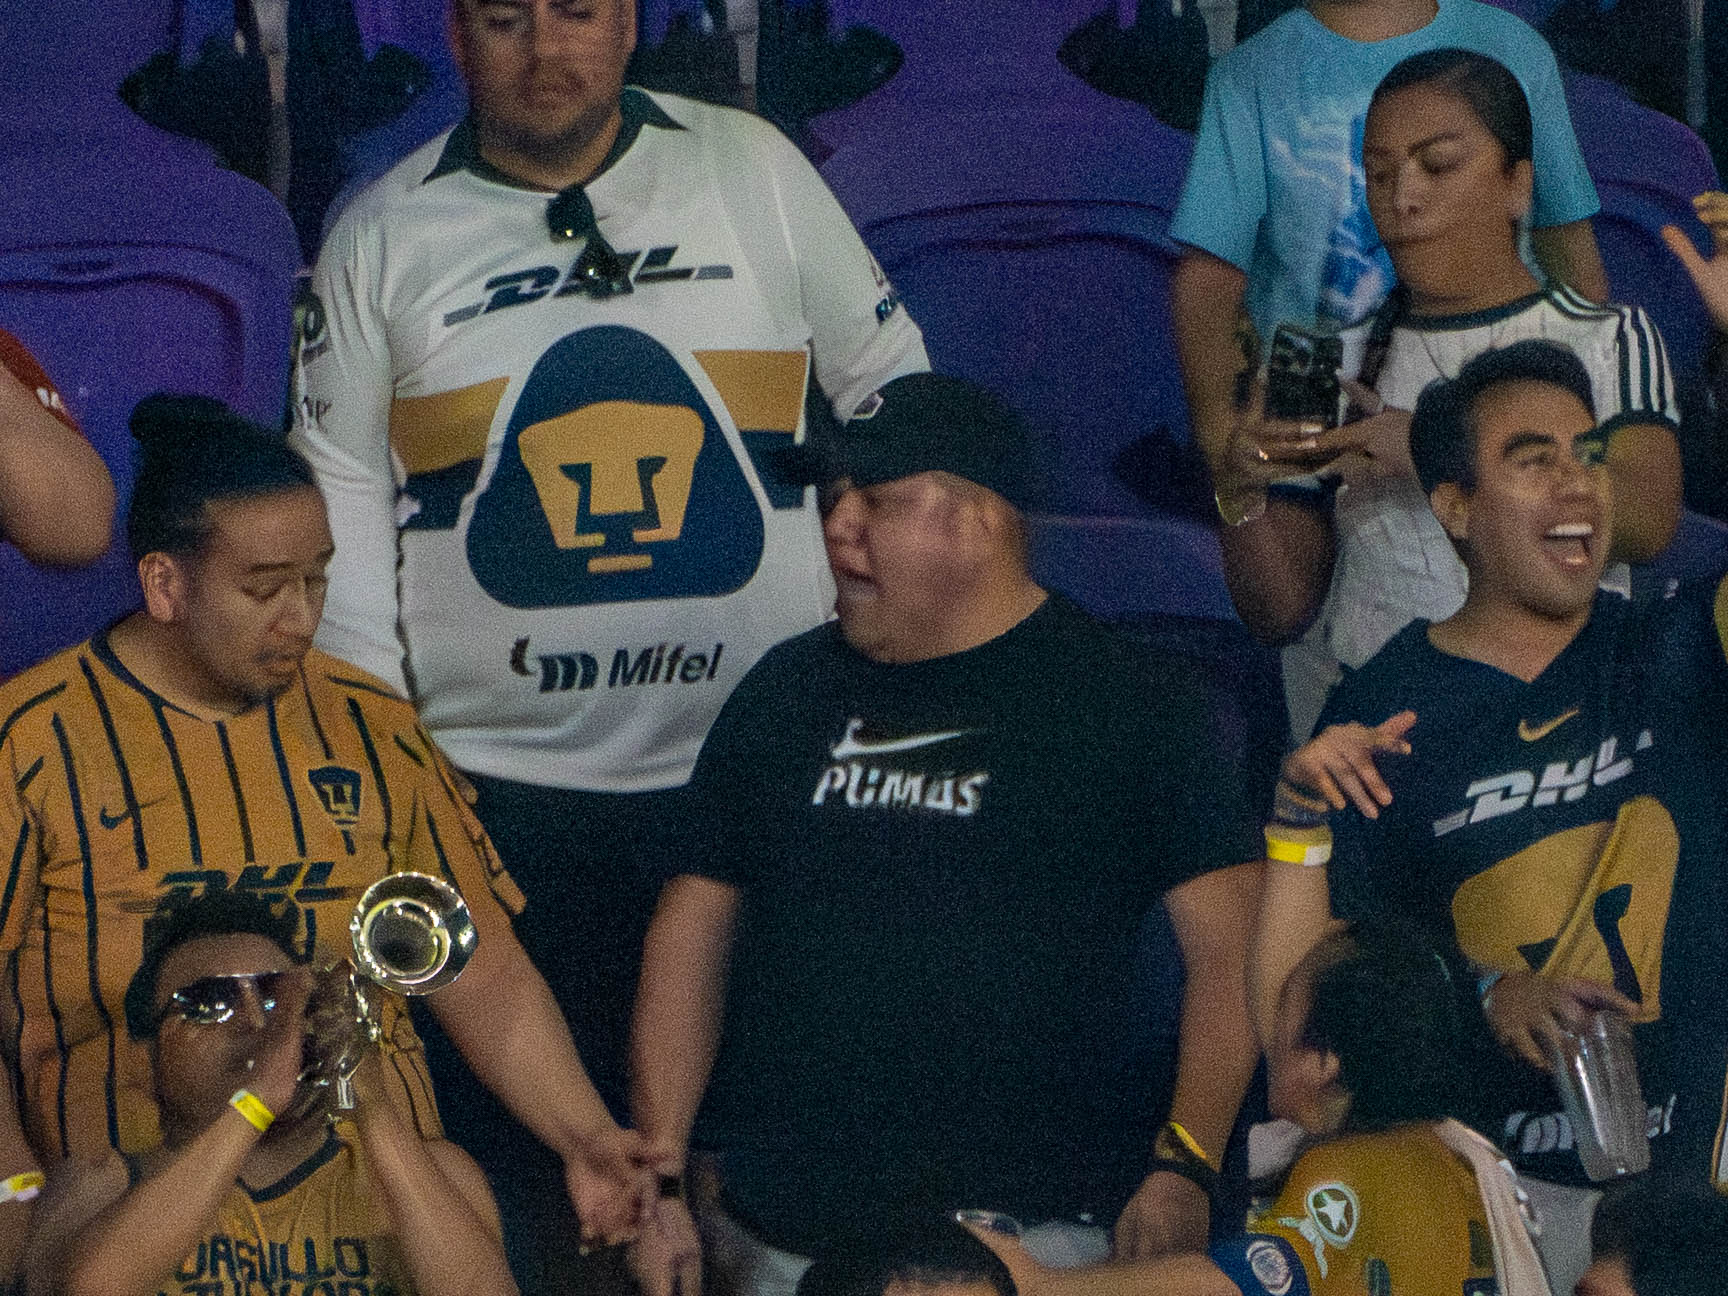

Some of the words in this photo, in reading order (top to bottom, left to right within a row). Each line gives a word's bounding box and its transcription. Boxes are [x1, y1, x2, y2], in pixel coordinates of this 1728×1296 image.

[608, 642, 724, 689] Mifel
[812, 762, 990, 816] PUMAS
[1466, 737, 1634, 825] DHL
